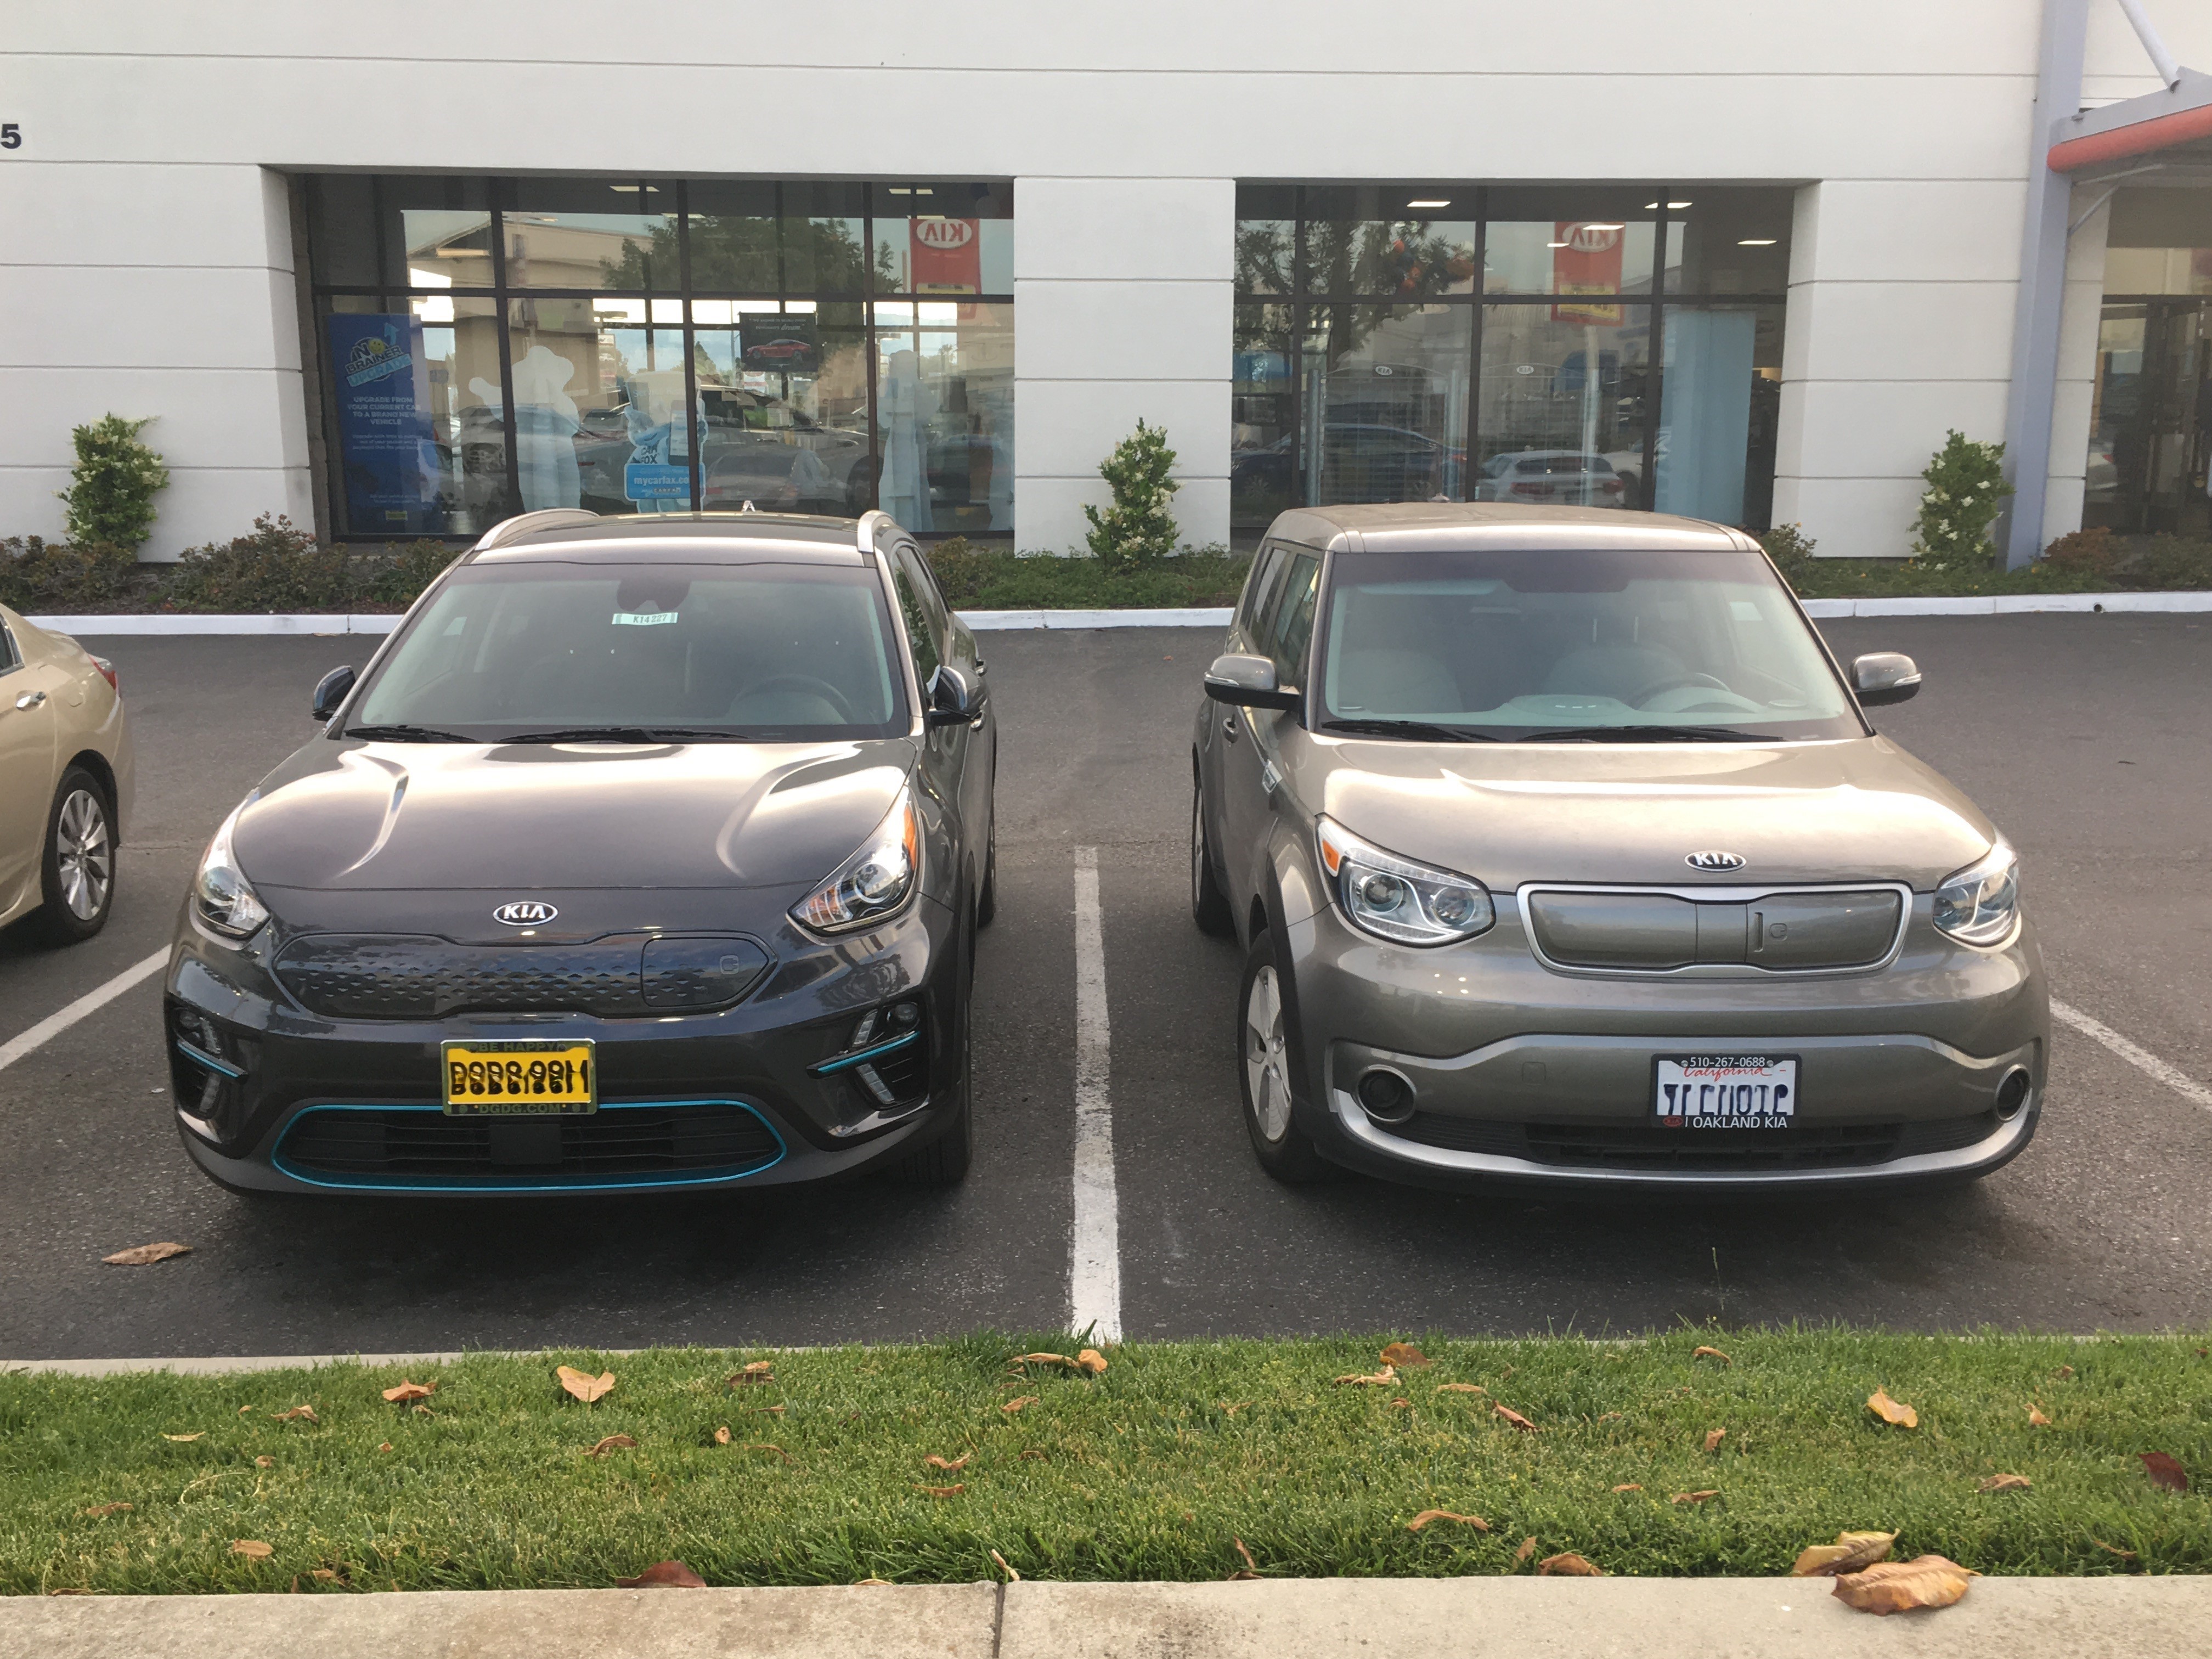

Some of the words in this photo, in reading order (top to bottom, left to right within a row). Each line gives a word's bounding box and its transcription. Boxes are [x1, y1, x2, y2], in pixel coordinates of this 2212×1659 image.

[0, 123, 21, 149] 5
[346, 346, 403, 374] BRAINER
[348, 354, 410, 385] UPGRADE
[634, 476, 689, 487] mycarfax.co
[1693, 853, 1738, 866] KIA
[503, 905, 546, 919] KIA
[504, 1042, 555, 1052] HAPPY
[1690, 1057, 1765, 1068] 510-267-0688
[479, 1103, 561, 1114] DGDG.COM
[1693, 1116, 1760, 1128] OAKLAND
[1764, 1116, 1788, 1128] KIA
